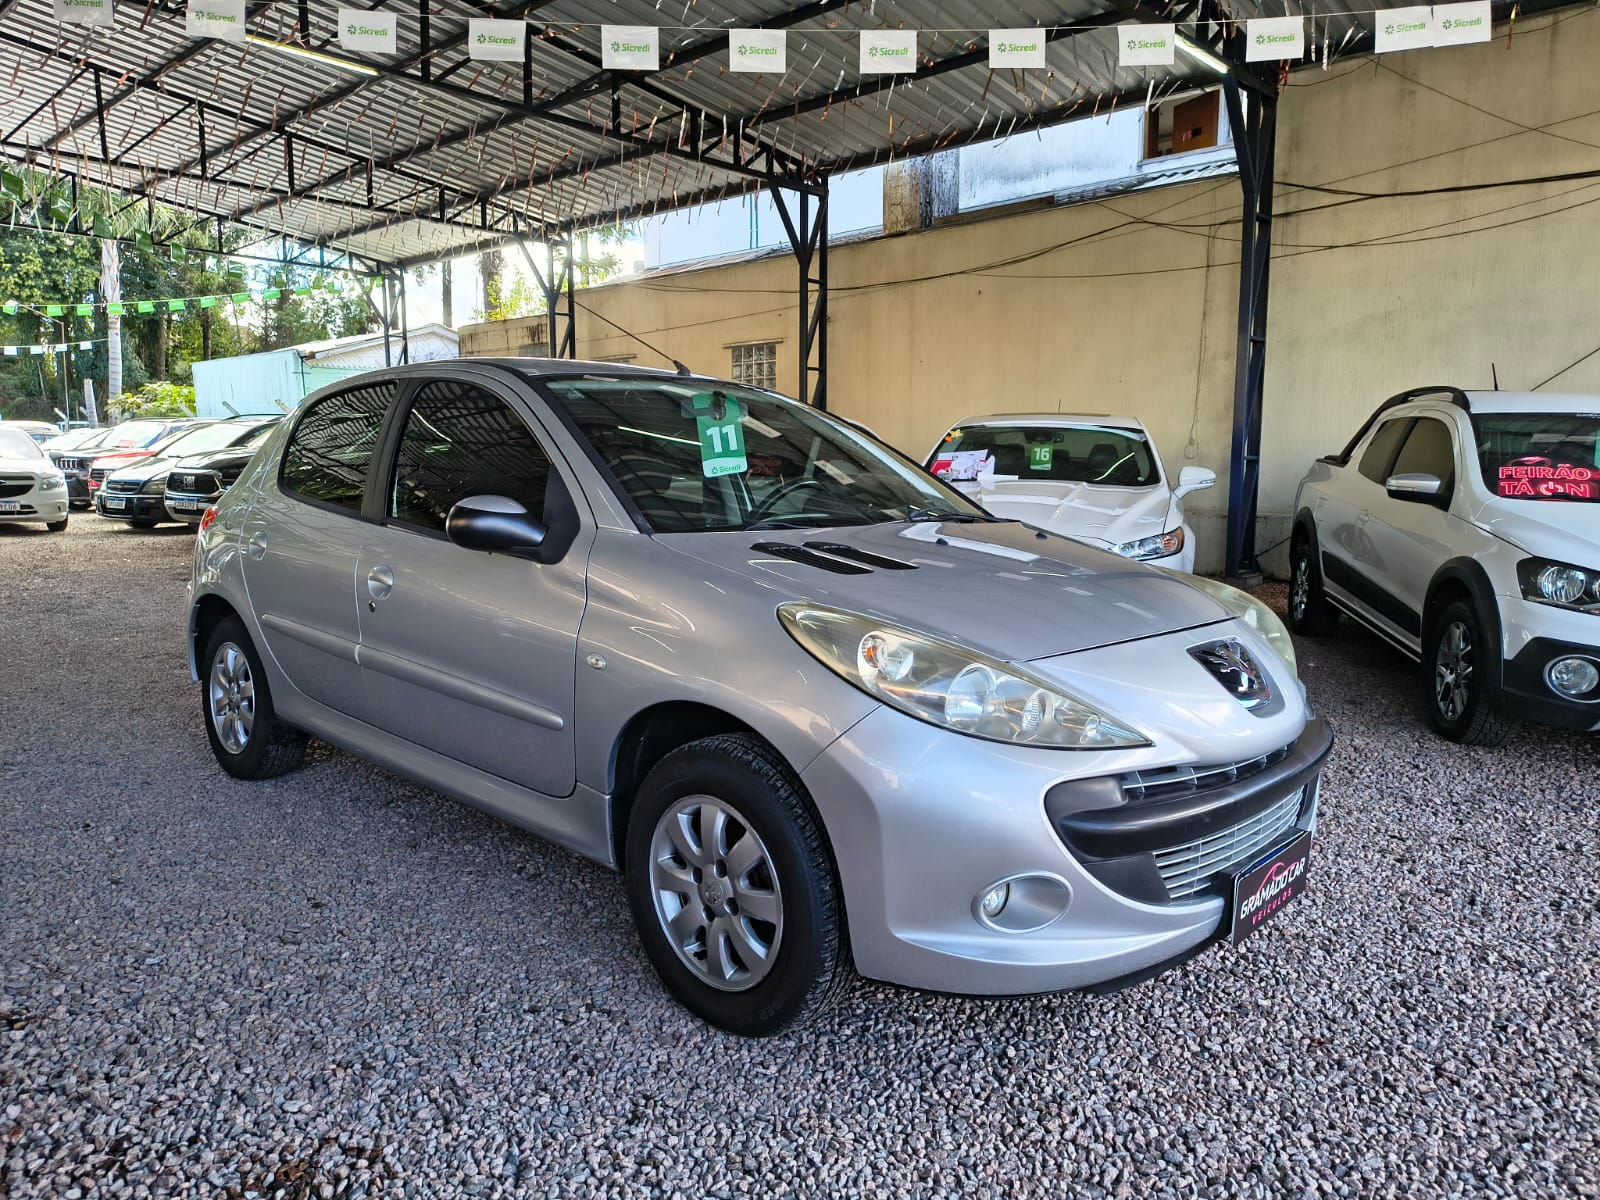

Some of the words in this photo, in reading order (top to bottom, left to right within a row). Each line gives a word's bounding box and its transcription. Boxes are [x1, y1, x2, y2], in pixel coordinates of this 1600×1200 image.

[73, 0, 104, 8] Sicredi
[206, 12, 236, 23] Sicredi
[1453, 17, 1482, 28] Sicredi
[358, 26, 388, 37] Sicredi
[1396, 22, 1426, 33] Sicredi
[487, 35, 517, 45] Sicredi
[1266, 34, 1296, 43] Sicredi
[621, 43, 650, 53] Sicredi
[1007, 43, 1037, 52] Sicredi
[1138, 40, 1166, 49] Sicredi
[749, 46, 777, 55] Sicredi
[879, 47, 908, 56] Sicredi
[706, 424, 738, 453] 11
[1033, 447, 1050, 461] 16
[1499, 464, 1591, 480] FEIRÃO
[1500, 478, 1535, 495] TÁ
